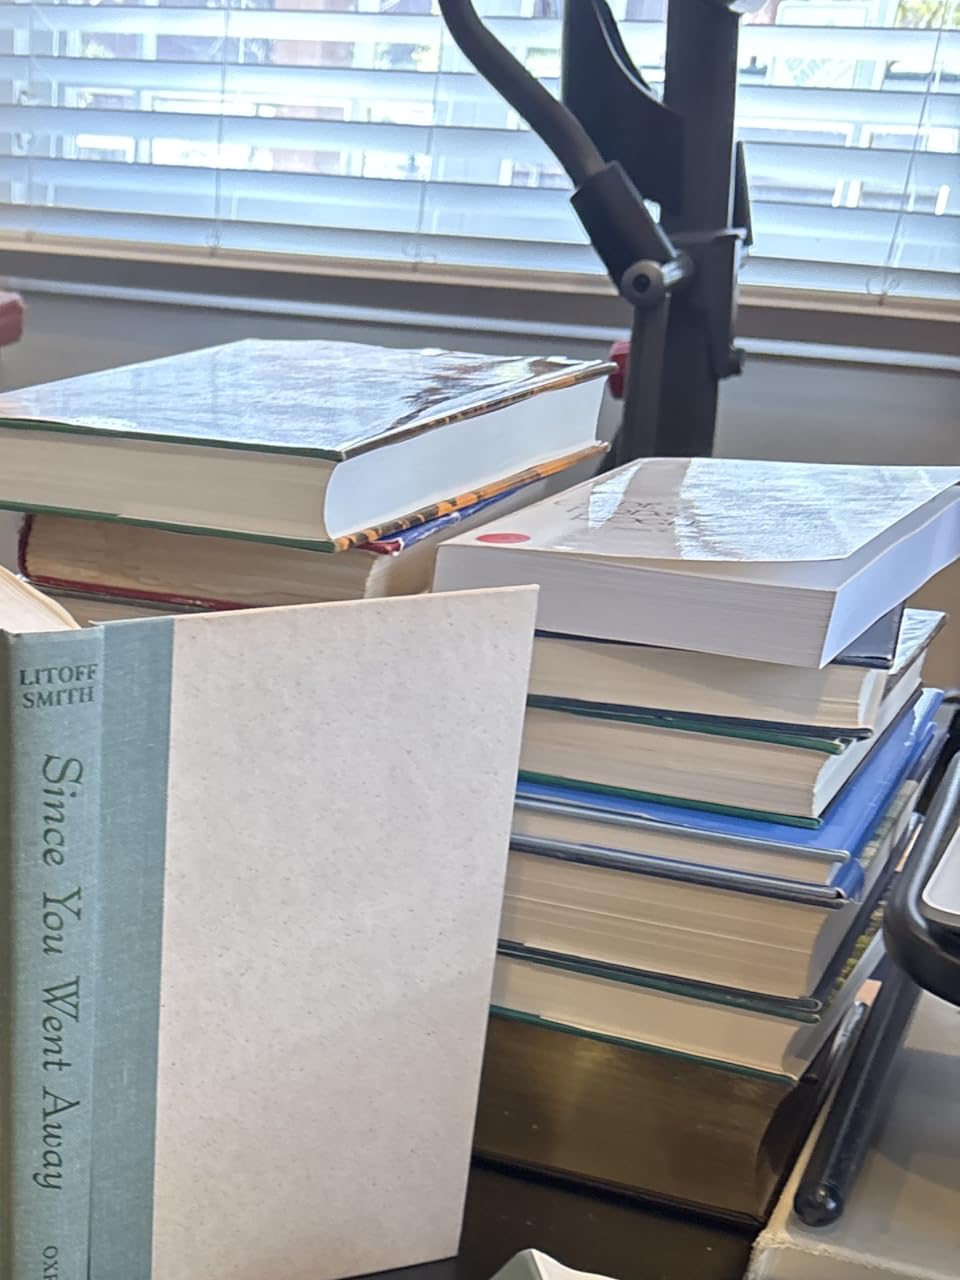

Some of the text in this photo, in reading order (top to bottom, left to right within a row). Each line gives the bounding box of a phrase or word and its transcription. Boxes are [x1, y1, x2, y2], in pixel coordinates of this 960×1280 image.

[20, 664, 98, 686] LITOFF
[22, 687, 94, 709] SMITH
[32, 754, 84, 1190] Since You Went Away
